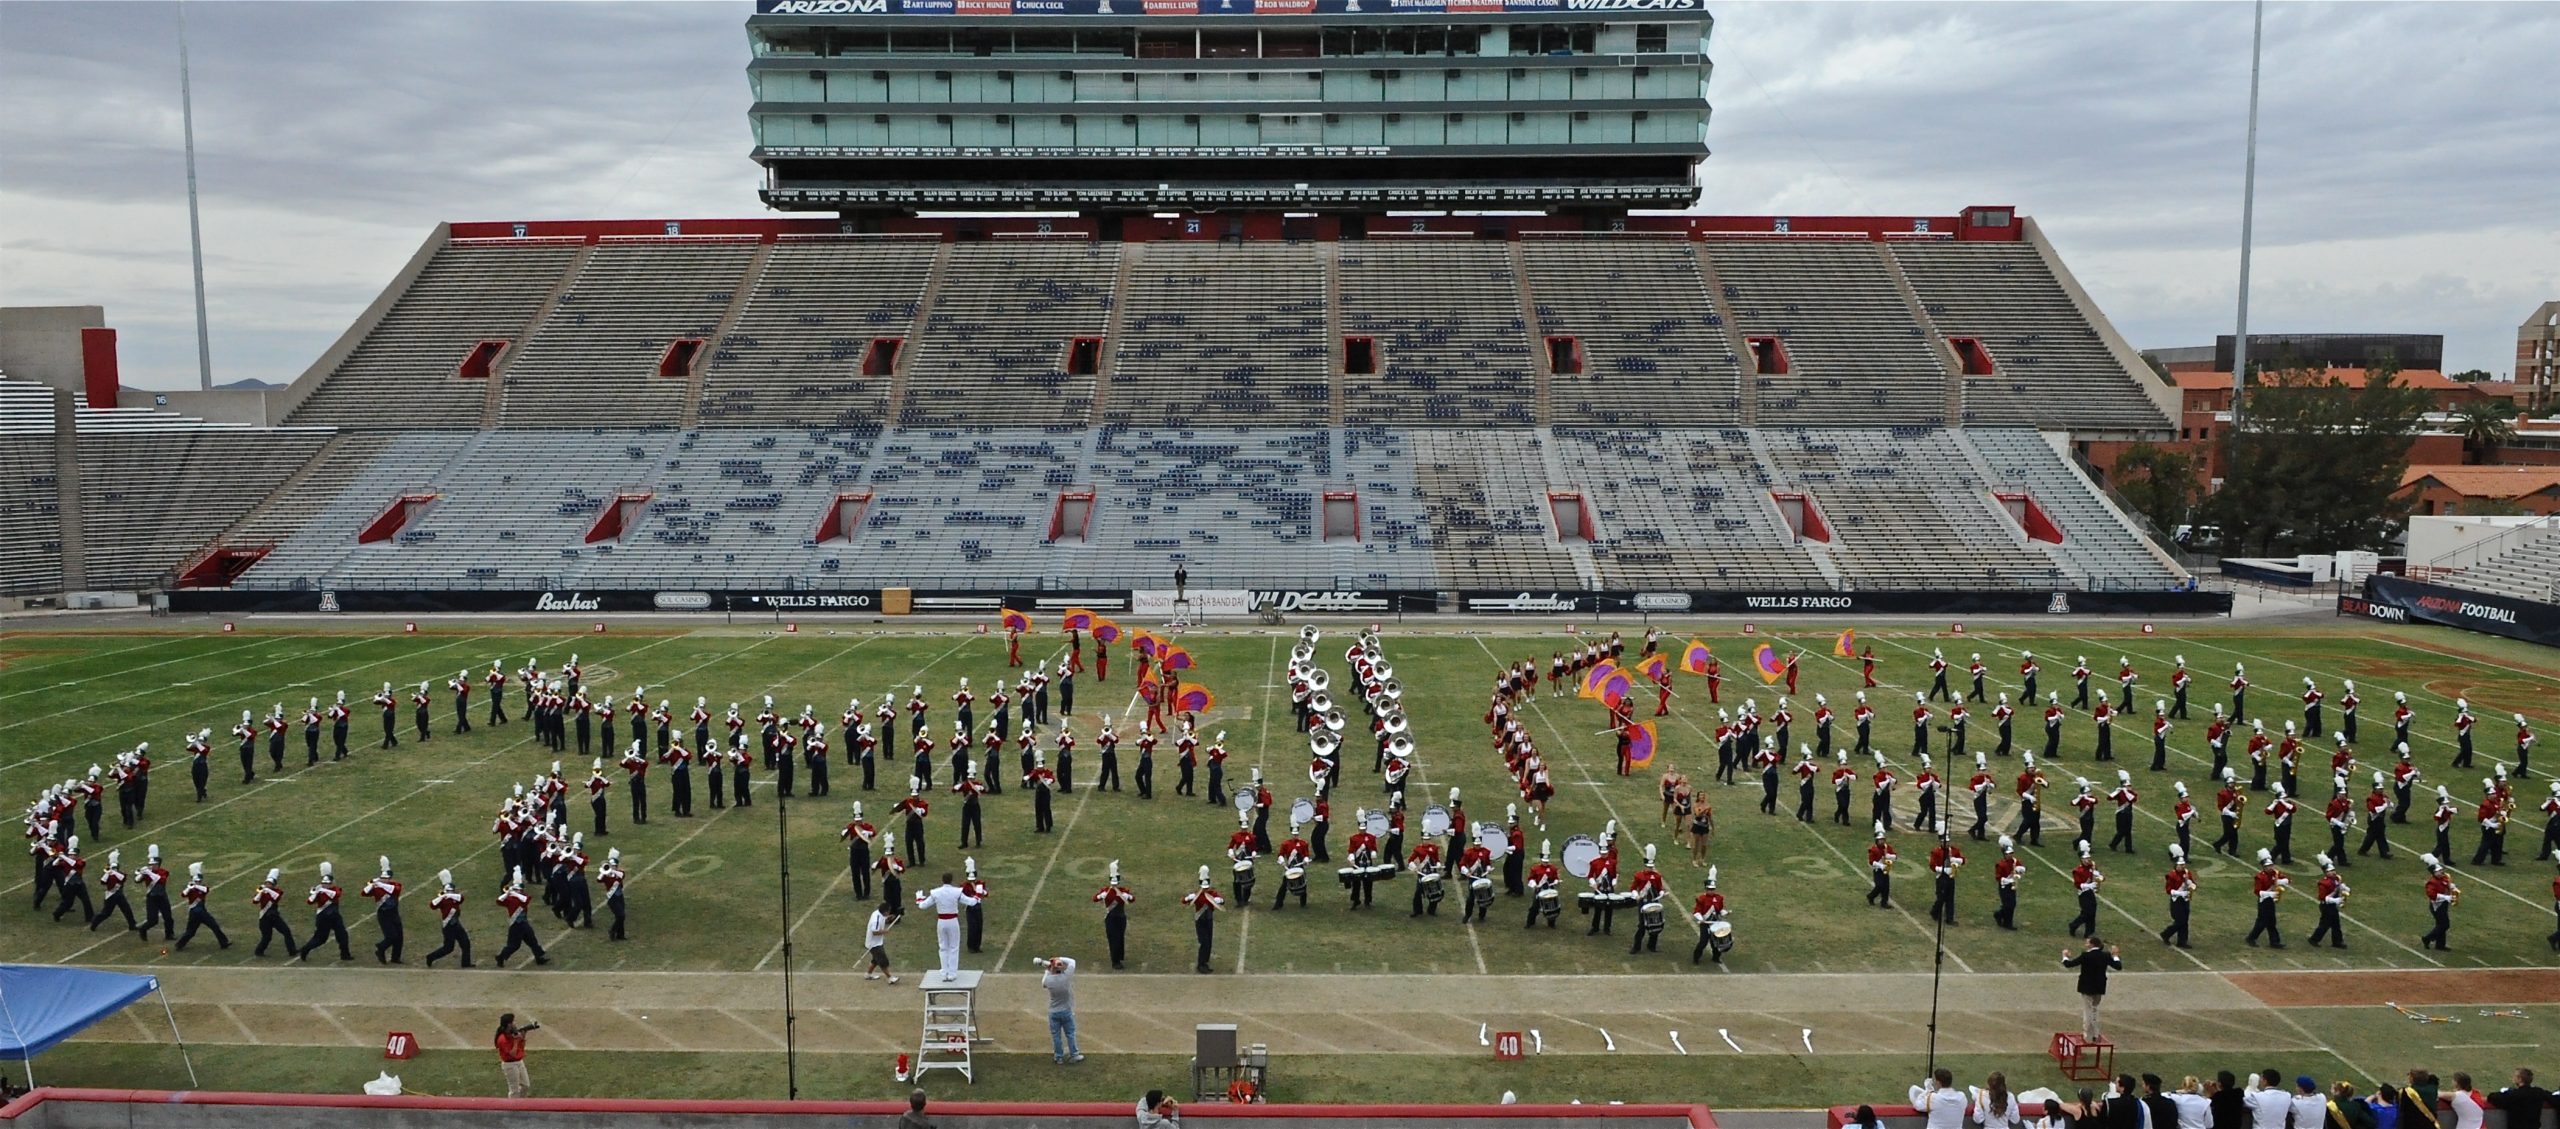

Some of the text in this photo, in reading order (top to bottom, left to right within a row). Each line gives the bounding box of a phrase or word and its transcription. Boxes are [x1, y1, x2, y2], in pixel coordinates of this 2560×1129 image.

[770, 0, 887, 13] ARIZONA
[903, 0, 952, 8] 22 ART LUPPINO
[966, 0, 986, 8] RICKY
[986, 0, 1011, 8] HUNLEY
[1022, 0, 1044, 8] CHUCK
[1046, 0, 1064, 8] CECIL
[1568, 0, 1695, 10] WILDCATS
[667, 226, 679, 235] 18
[842, 225, 852, 234] 19
[1038, 224, 1051, 232] 20
[1188, 223, 1199, 232] 21
[1412, 224, 1425, 232] 22
[1612, 223, 1625, 231] 23
[1775, 224, 1788, 232] 24
[1915, 224, 1928, 232] 25
[515, 229, 526, 238] 17
[156, 396, 166, 404] 16
[536, 592, 601, 610] Bashas'
[765, 596, 870, 606] WELLS FARGO
[1136, 597, 1170, 607] UNIVERSITY
[1212, 597, 1230, 607] BAND
[1232, 597, 1245, 607] DAY
[1248, 592, 1362, 611] WILDCATS
[1746, 597, 1852, 608] WELLS FARGO
[387, 1036, 406, 1056] 40
[947, 1037, 962, 1052] 50
[1500, 1036, 1518, 1056] 40
